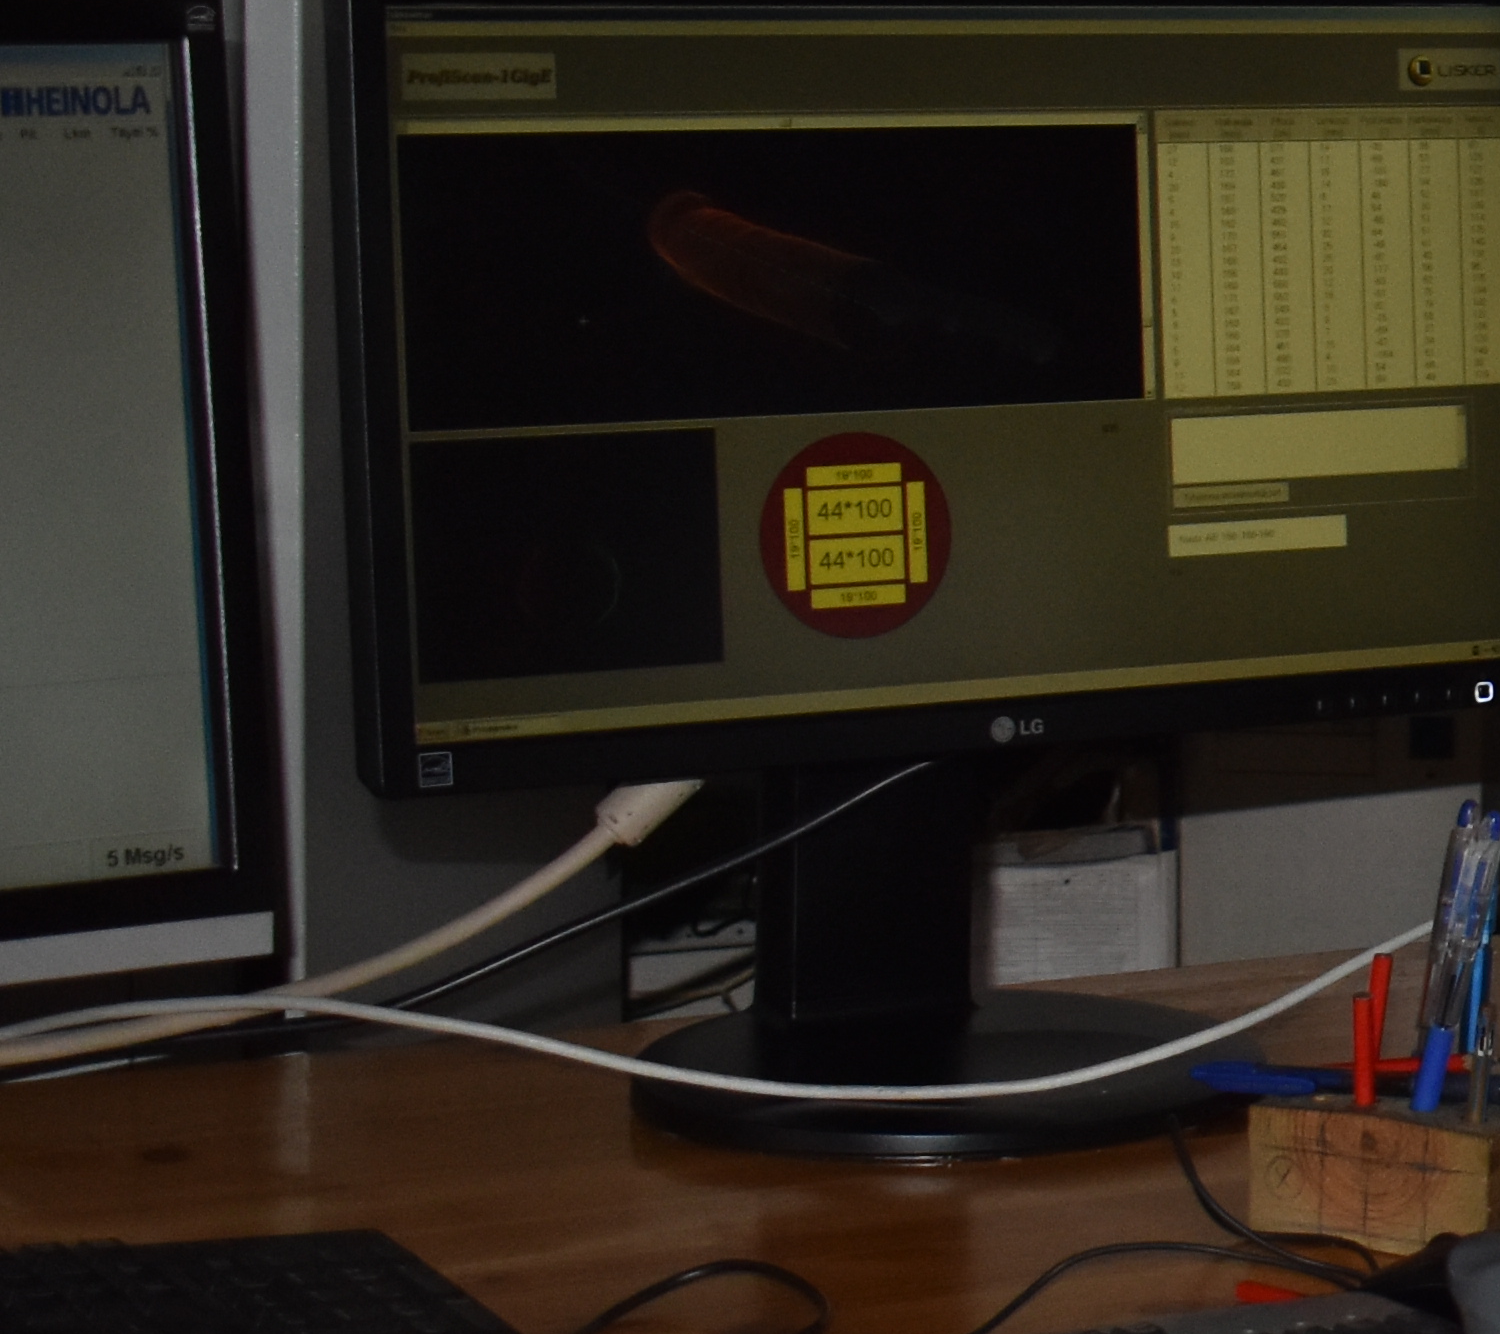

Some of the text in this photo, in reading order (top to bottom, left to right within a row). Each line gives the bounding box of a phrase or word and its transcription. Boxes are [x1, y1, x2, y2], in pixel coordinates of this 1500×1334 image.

[1438, 64, 1496, 77] LISKER
[26, 85, 151, 116] HEINOLA
[1020, 718, 1045, 734] LG
[107, 843, 185, 867] 5 Msg/s
